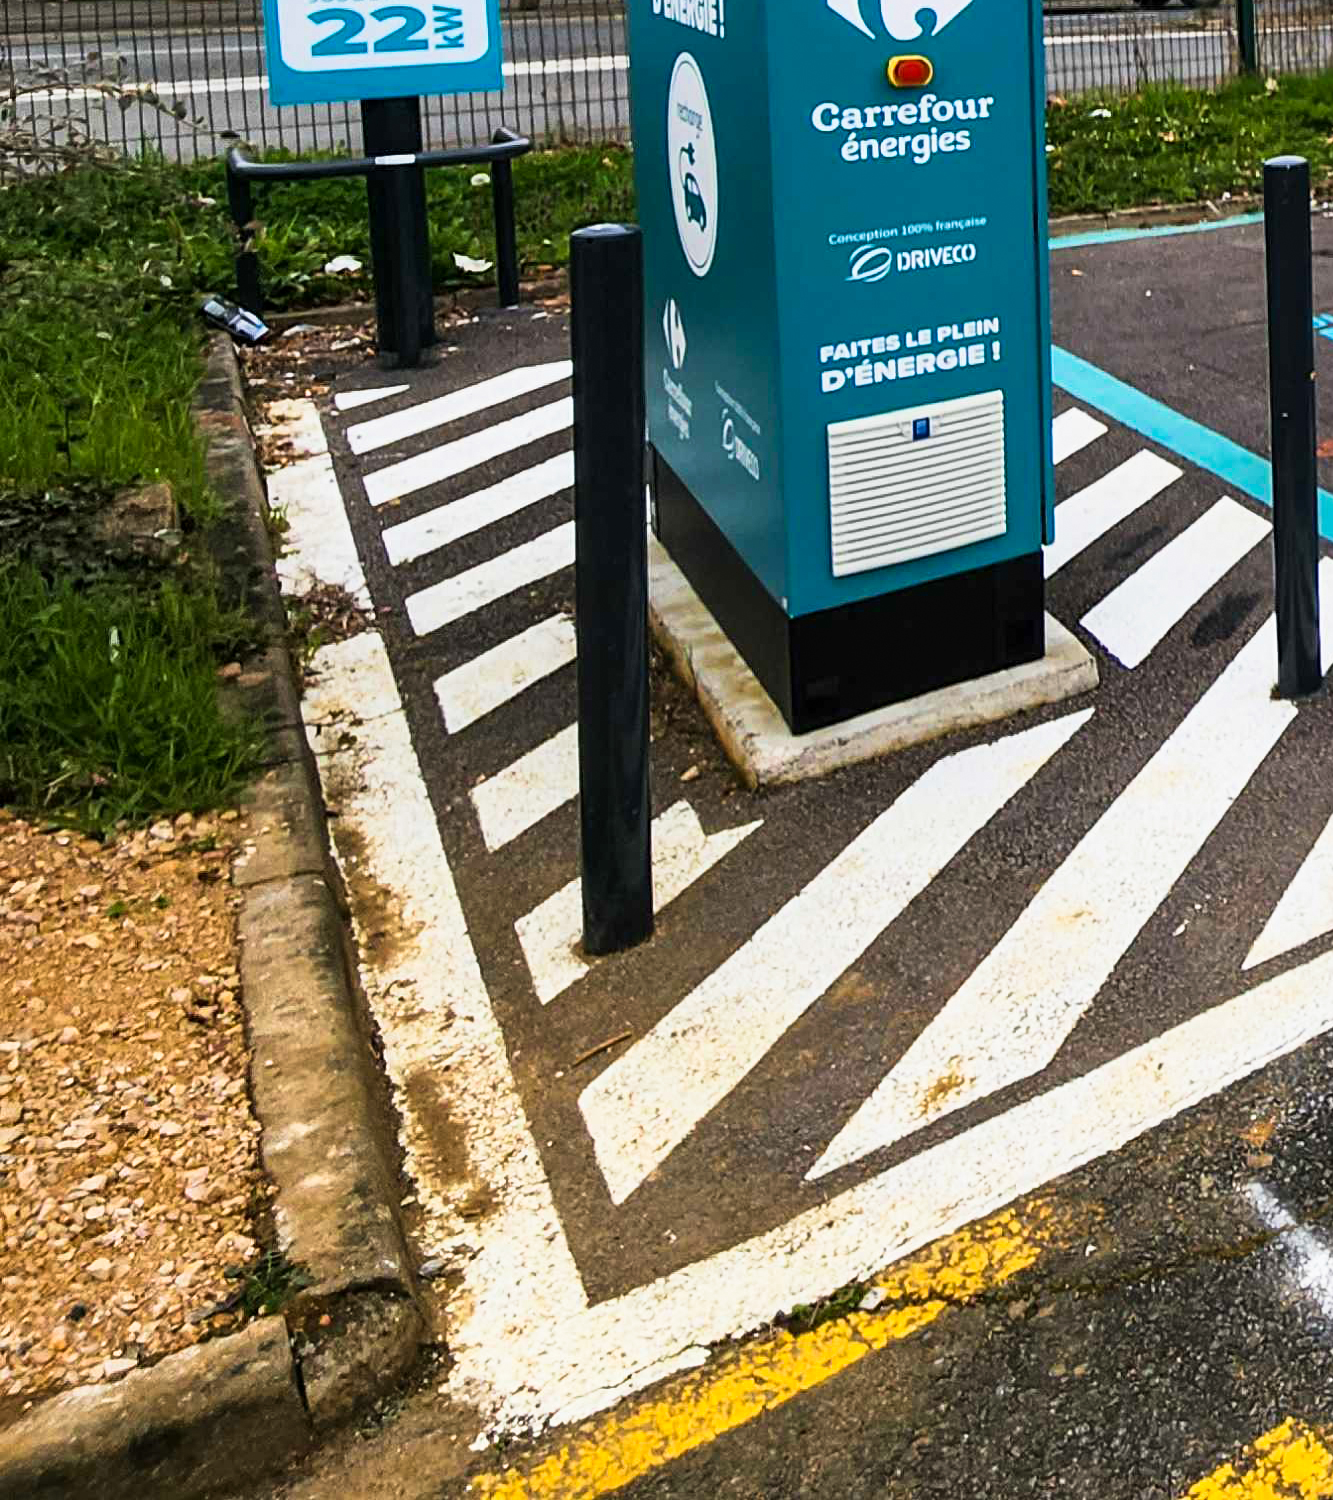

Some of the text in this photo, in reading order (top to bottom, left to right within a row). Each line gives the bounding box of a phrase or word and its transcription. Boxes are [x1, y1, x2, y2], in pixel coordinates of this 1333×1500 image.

[307, 4, 465, 56] 22 kW
[811, 93, 995, 132] Carrefour
[841, 126, 971, 164] énergies
[828, 215, 987, 245] Conception 100% française
[896, 243, 977, 272] DRIVECO
[819, 317, 1000, 364] FAITES LE PLEIN
